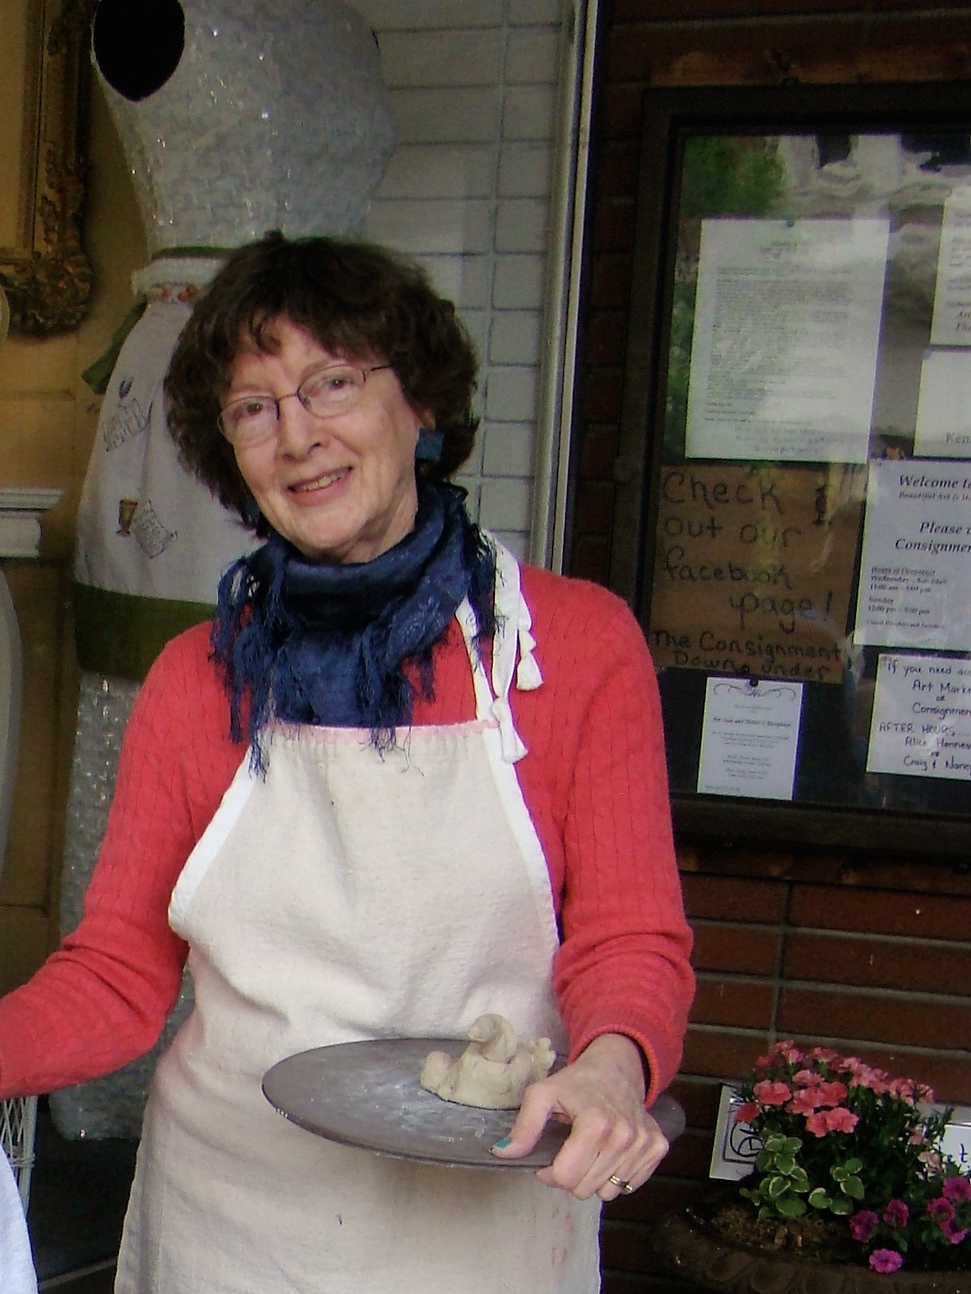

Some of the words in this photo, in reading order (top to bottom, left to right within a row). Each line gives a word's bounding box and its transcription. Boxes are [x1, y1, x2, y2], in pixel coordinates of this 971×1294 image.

[898, 474, 959, 490] Welcome
[662, 471, 784, 514] Check
[919, 521, 963, 536] Please
[652, 629, 690, 648] The
[699, 630, 842, 664] Consignment
[888, 658, 898, 674] If
[903, 665, 922, 677] you
[929, 665, 952, 675] need
[912, 679, 934, 692] Art
[879, 721, 915, 734] AFTER
